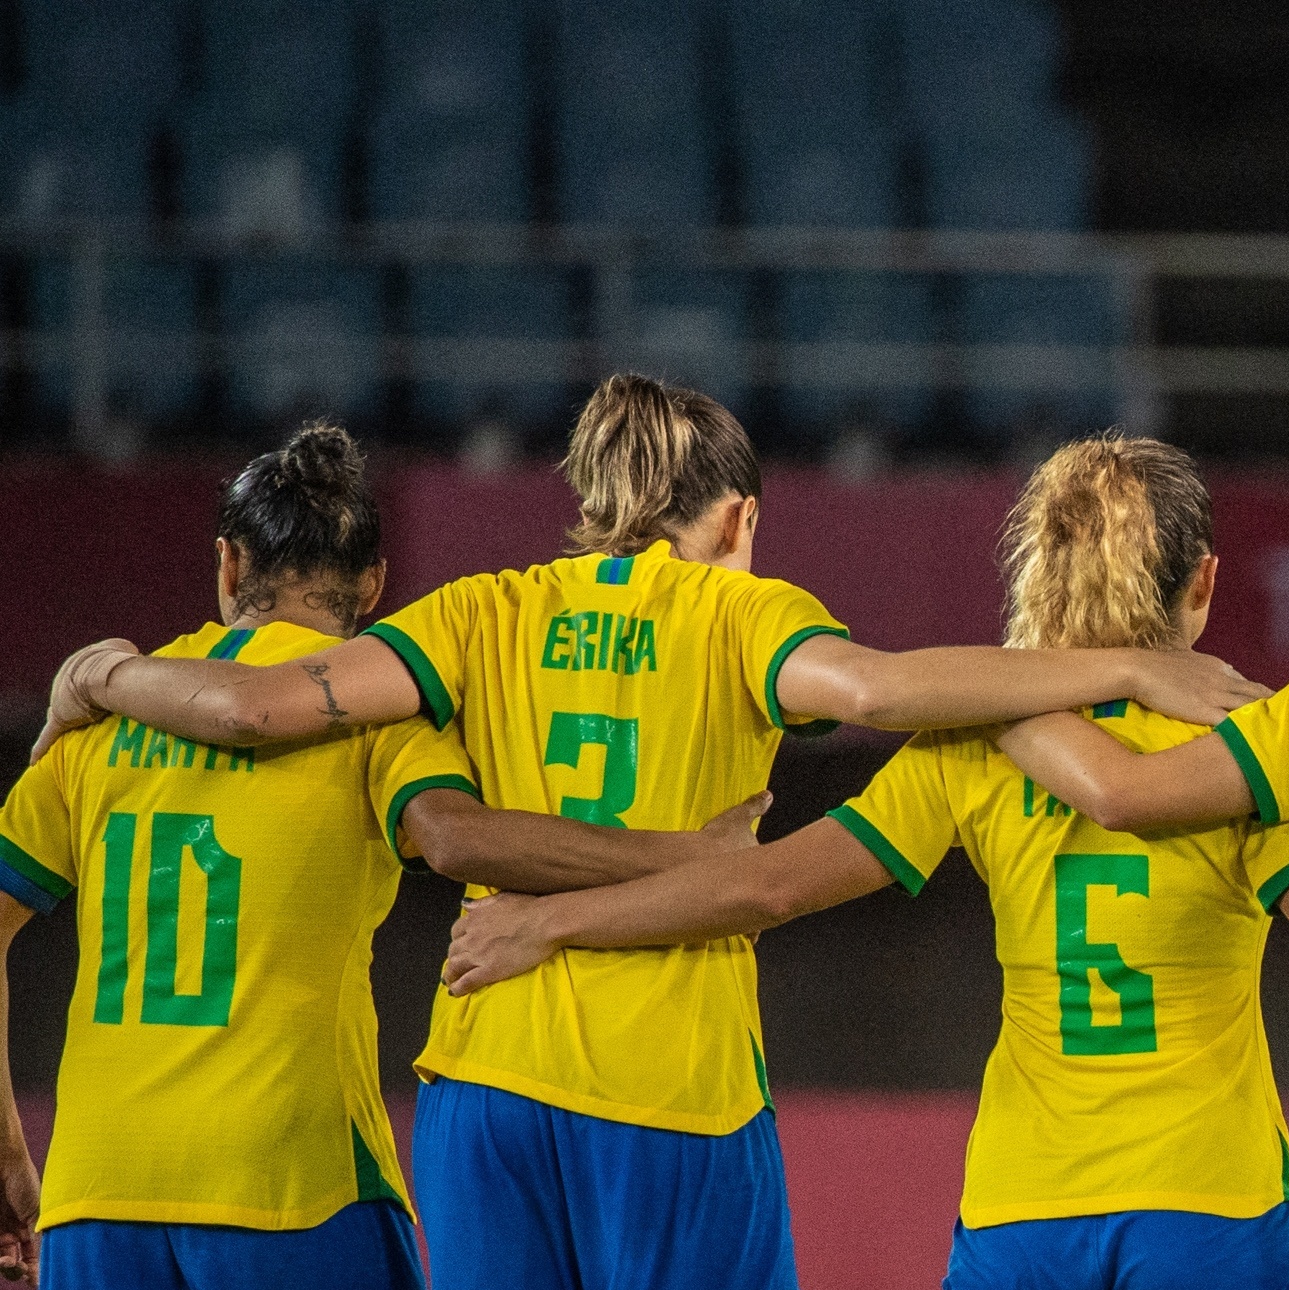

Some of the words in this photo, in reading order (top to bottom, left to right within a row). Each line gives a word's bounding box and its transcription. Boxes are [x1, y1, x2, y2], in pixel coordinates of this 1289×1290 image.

[541, 608, 657, 675] ÉRIKA
[544, 711, 639, 829] 3
[93, 812, 242, 1027] 10
[1054, 853, 1157, 1055] 6
